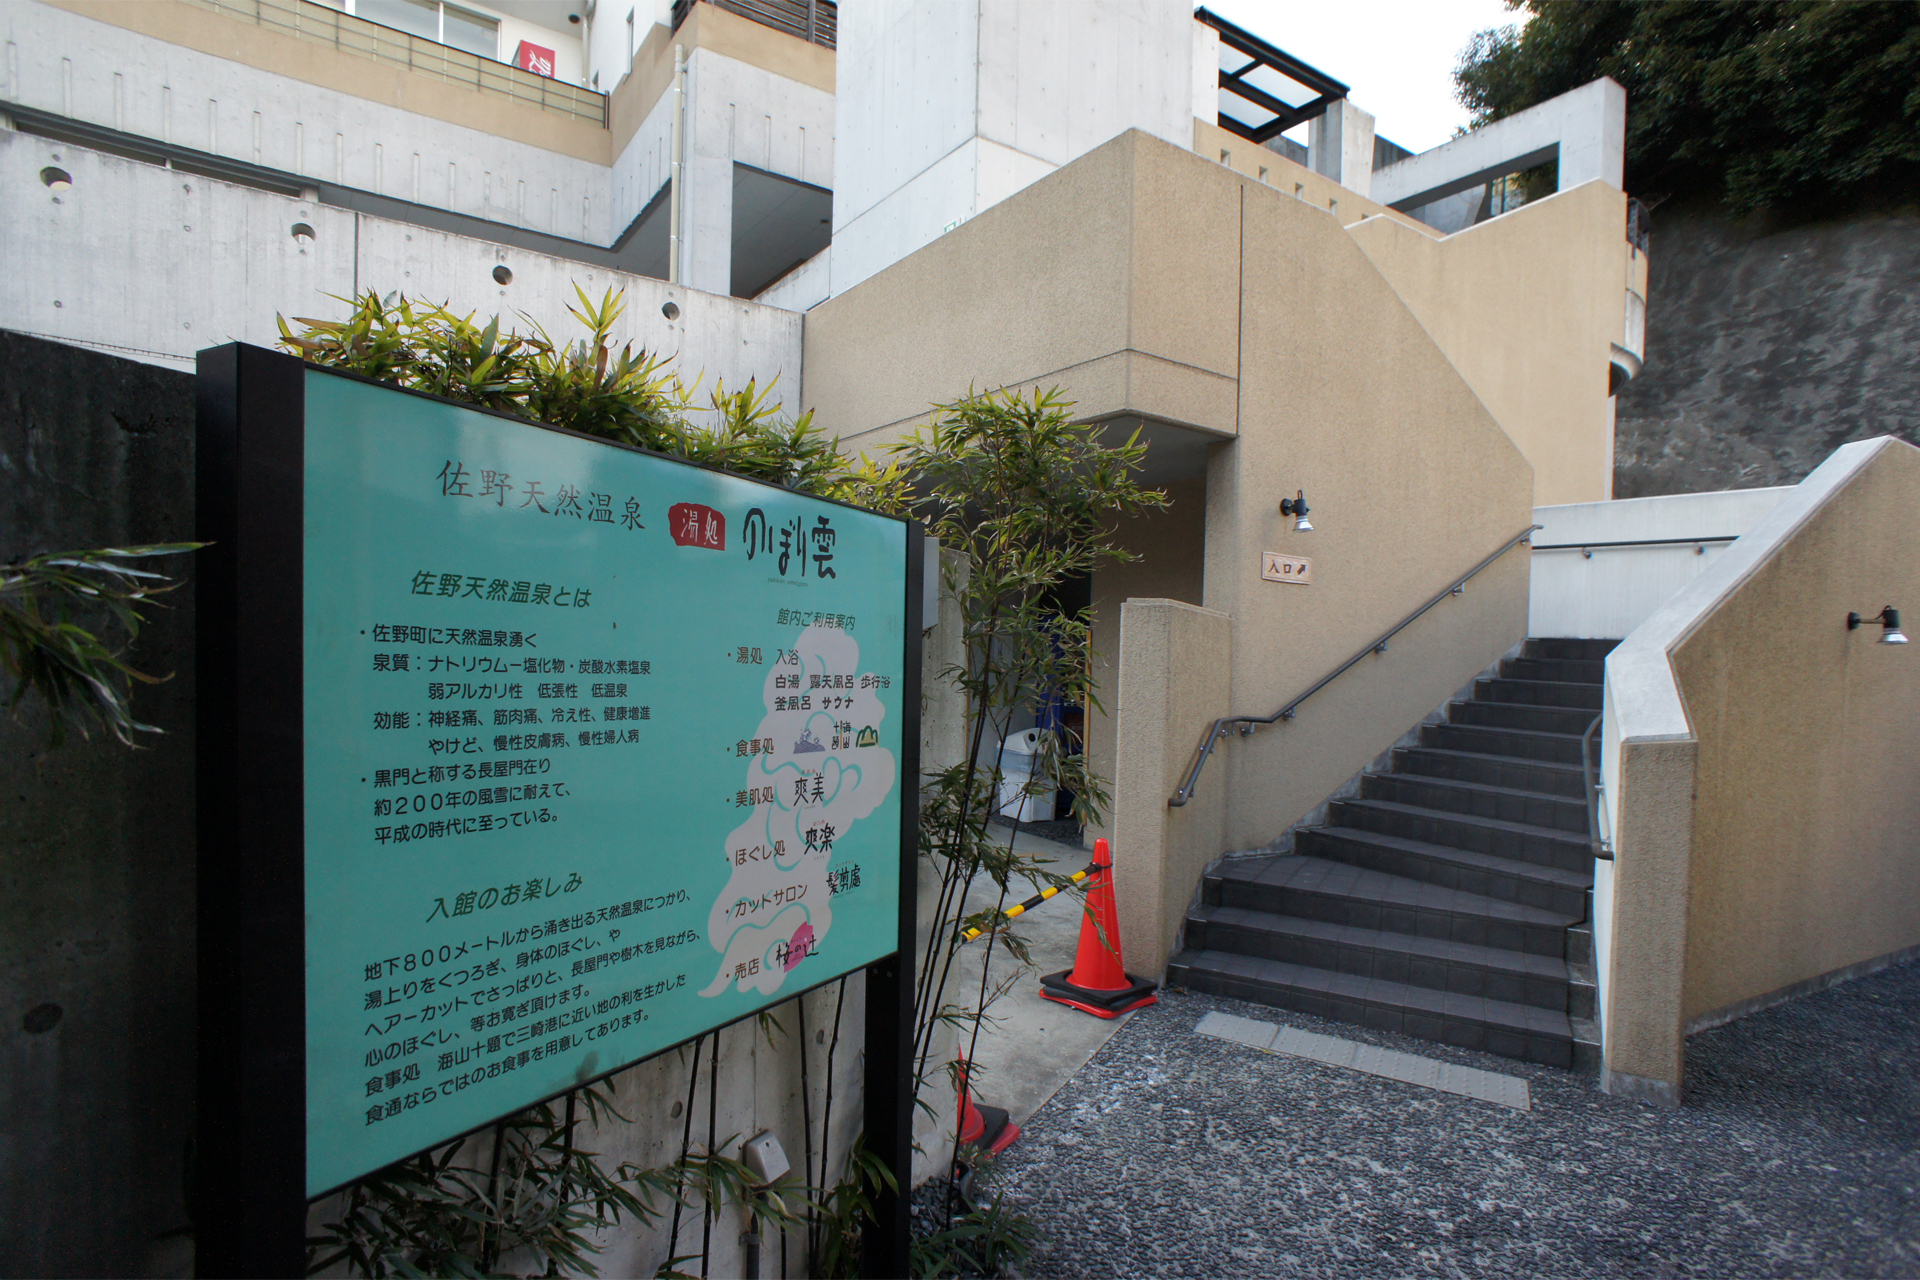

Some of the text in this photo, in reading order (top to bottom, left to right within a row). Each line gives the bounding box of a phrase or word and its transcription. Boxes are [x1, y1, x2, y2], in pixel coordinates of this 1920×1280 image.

[436, 460, 646, 531] 佐野天然温泉
[743, 508, 836, 579] のぼり雲
[1269, 559, 1292, 574] 入口
[411, 570, 591, 609] 佐野天然温泉とは
[776, 608, 856, 630] 館内ご利用案内
[373, 623, 538, 649] 佐野町に天然温泉湧く
[736, 646, 799, 665] 湯処 入浴
[428, 682, 628, 700] 弱アルカリ性 低張性 低温泉
[775, 674, 891, 689] 白湯 露天風呂 歩行浴
[774, 696, 854, 711] 釜風呂 サウナ
[735, 738, 774, 758] 食事処
[373, 758, 551, 789] 黒門と称する長屋門在り
[735, 785, 774, 808] 美肌処
[374, 808, 558, 845] 平成の時代に至っている。
[735, 840, 786, 867] ほぐし処
[426, 872, 583, 923] 入館のお楽しみ
[735, 883, 808, 918] カットサロン
[735, 958, 760, 981] 売店
[365, 983, 590, 1068] 心のほぐし、等お寛ぎ頂けます。
[365, 1009, 649, 1127] 食通ならではのお食事を用意してあります。
[365, 1062, 421, 1098] 食事処
